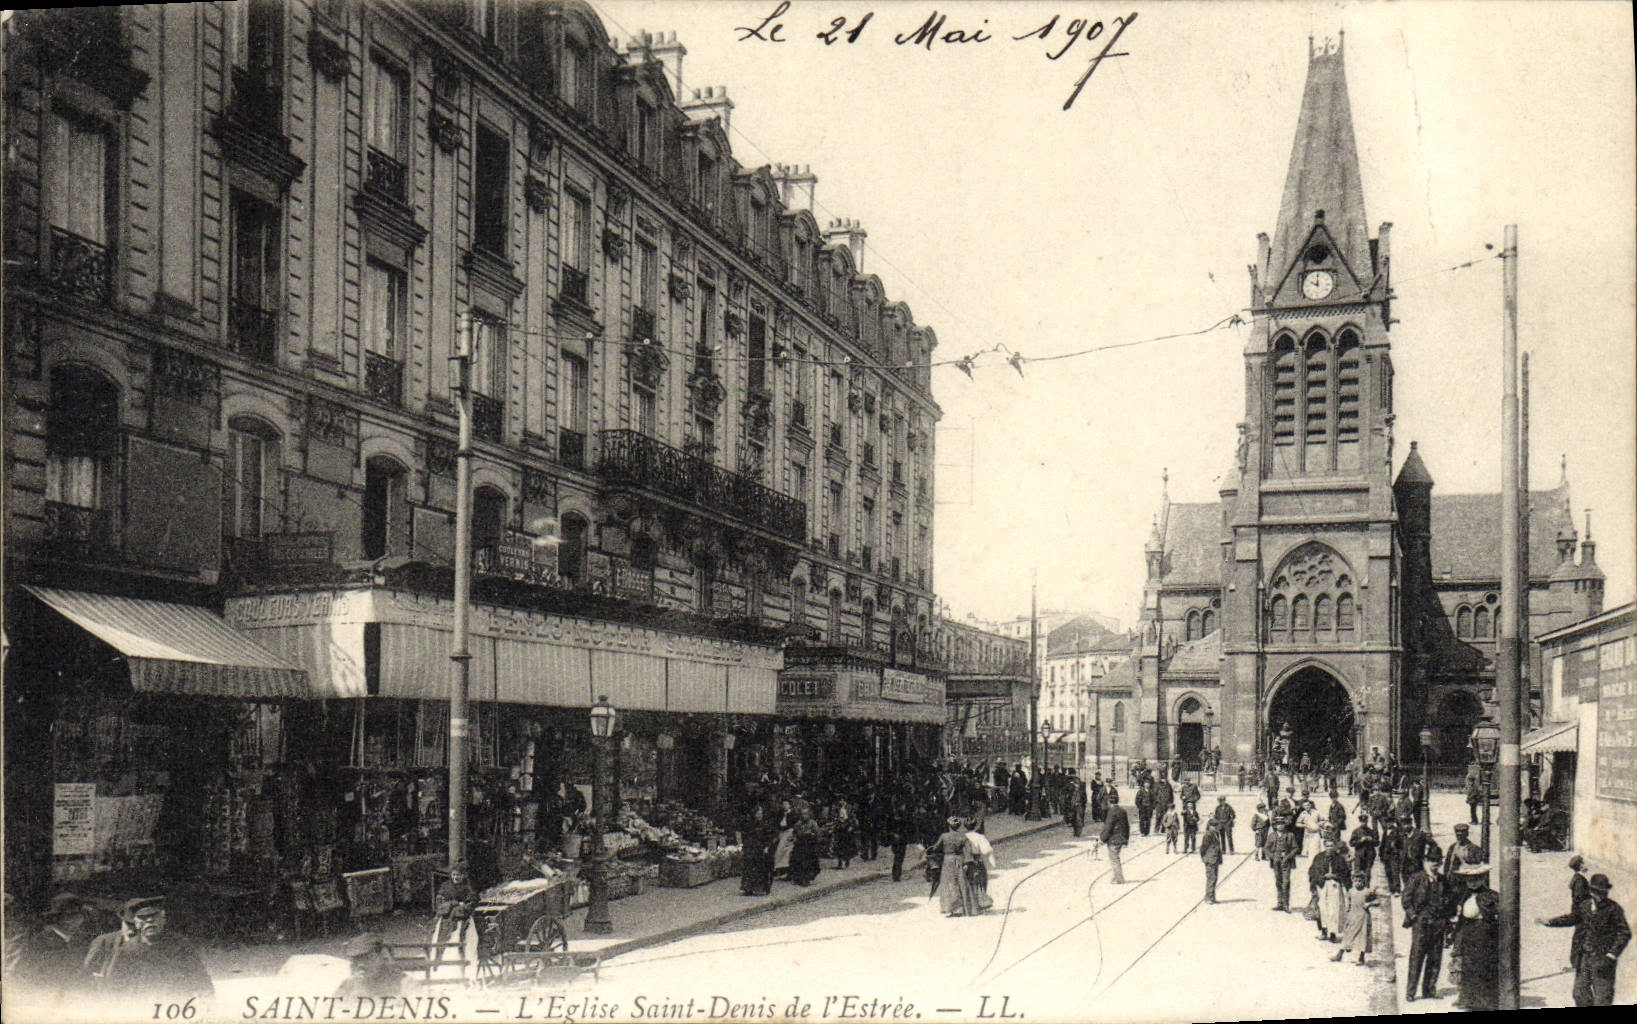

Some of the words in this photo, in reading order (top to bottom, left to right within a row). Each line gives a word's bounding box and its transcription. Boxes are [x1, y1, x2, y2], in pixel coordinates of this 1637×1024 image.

[734, 0, 791, 43] Le
[816, 12, 875, 46] 21
[894, 10, 993, 51] Mai
[1012, 12, 1139, 112] 1907
